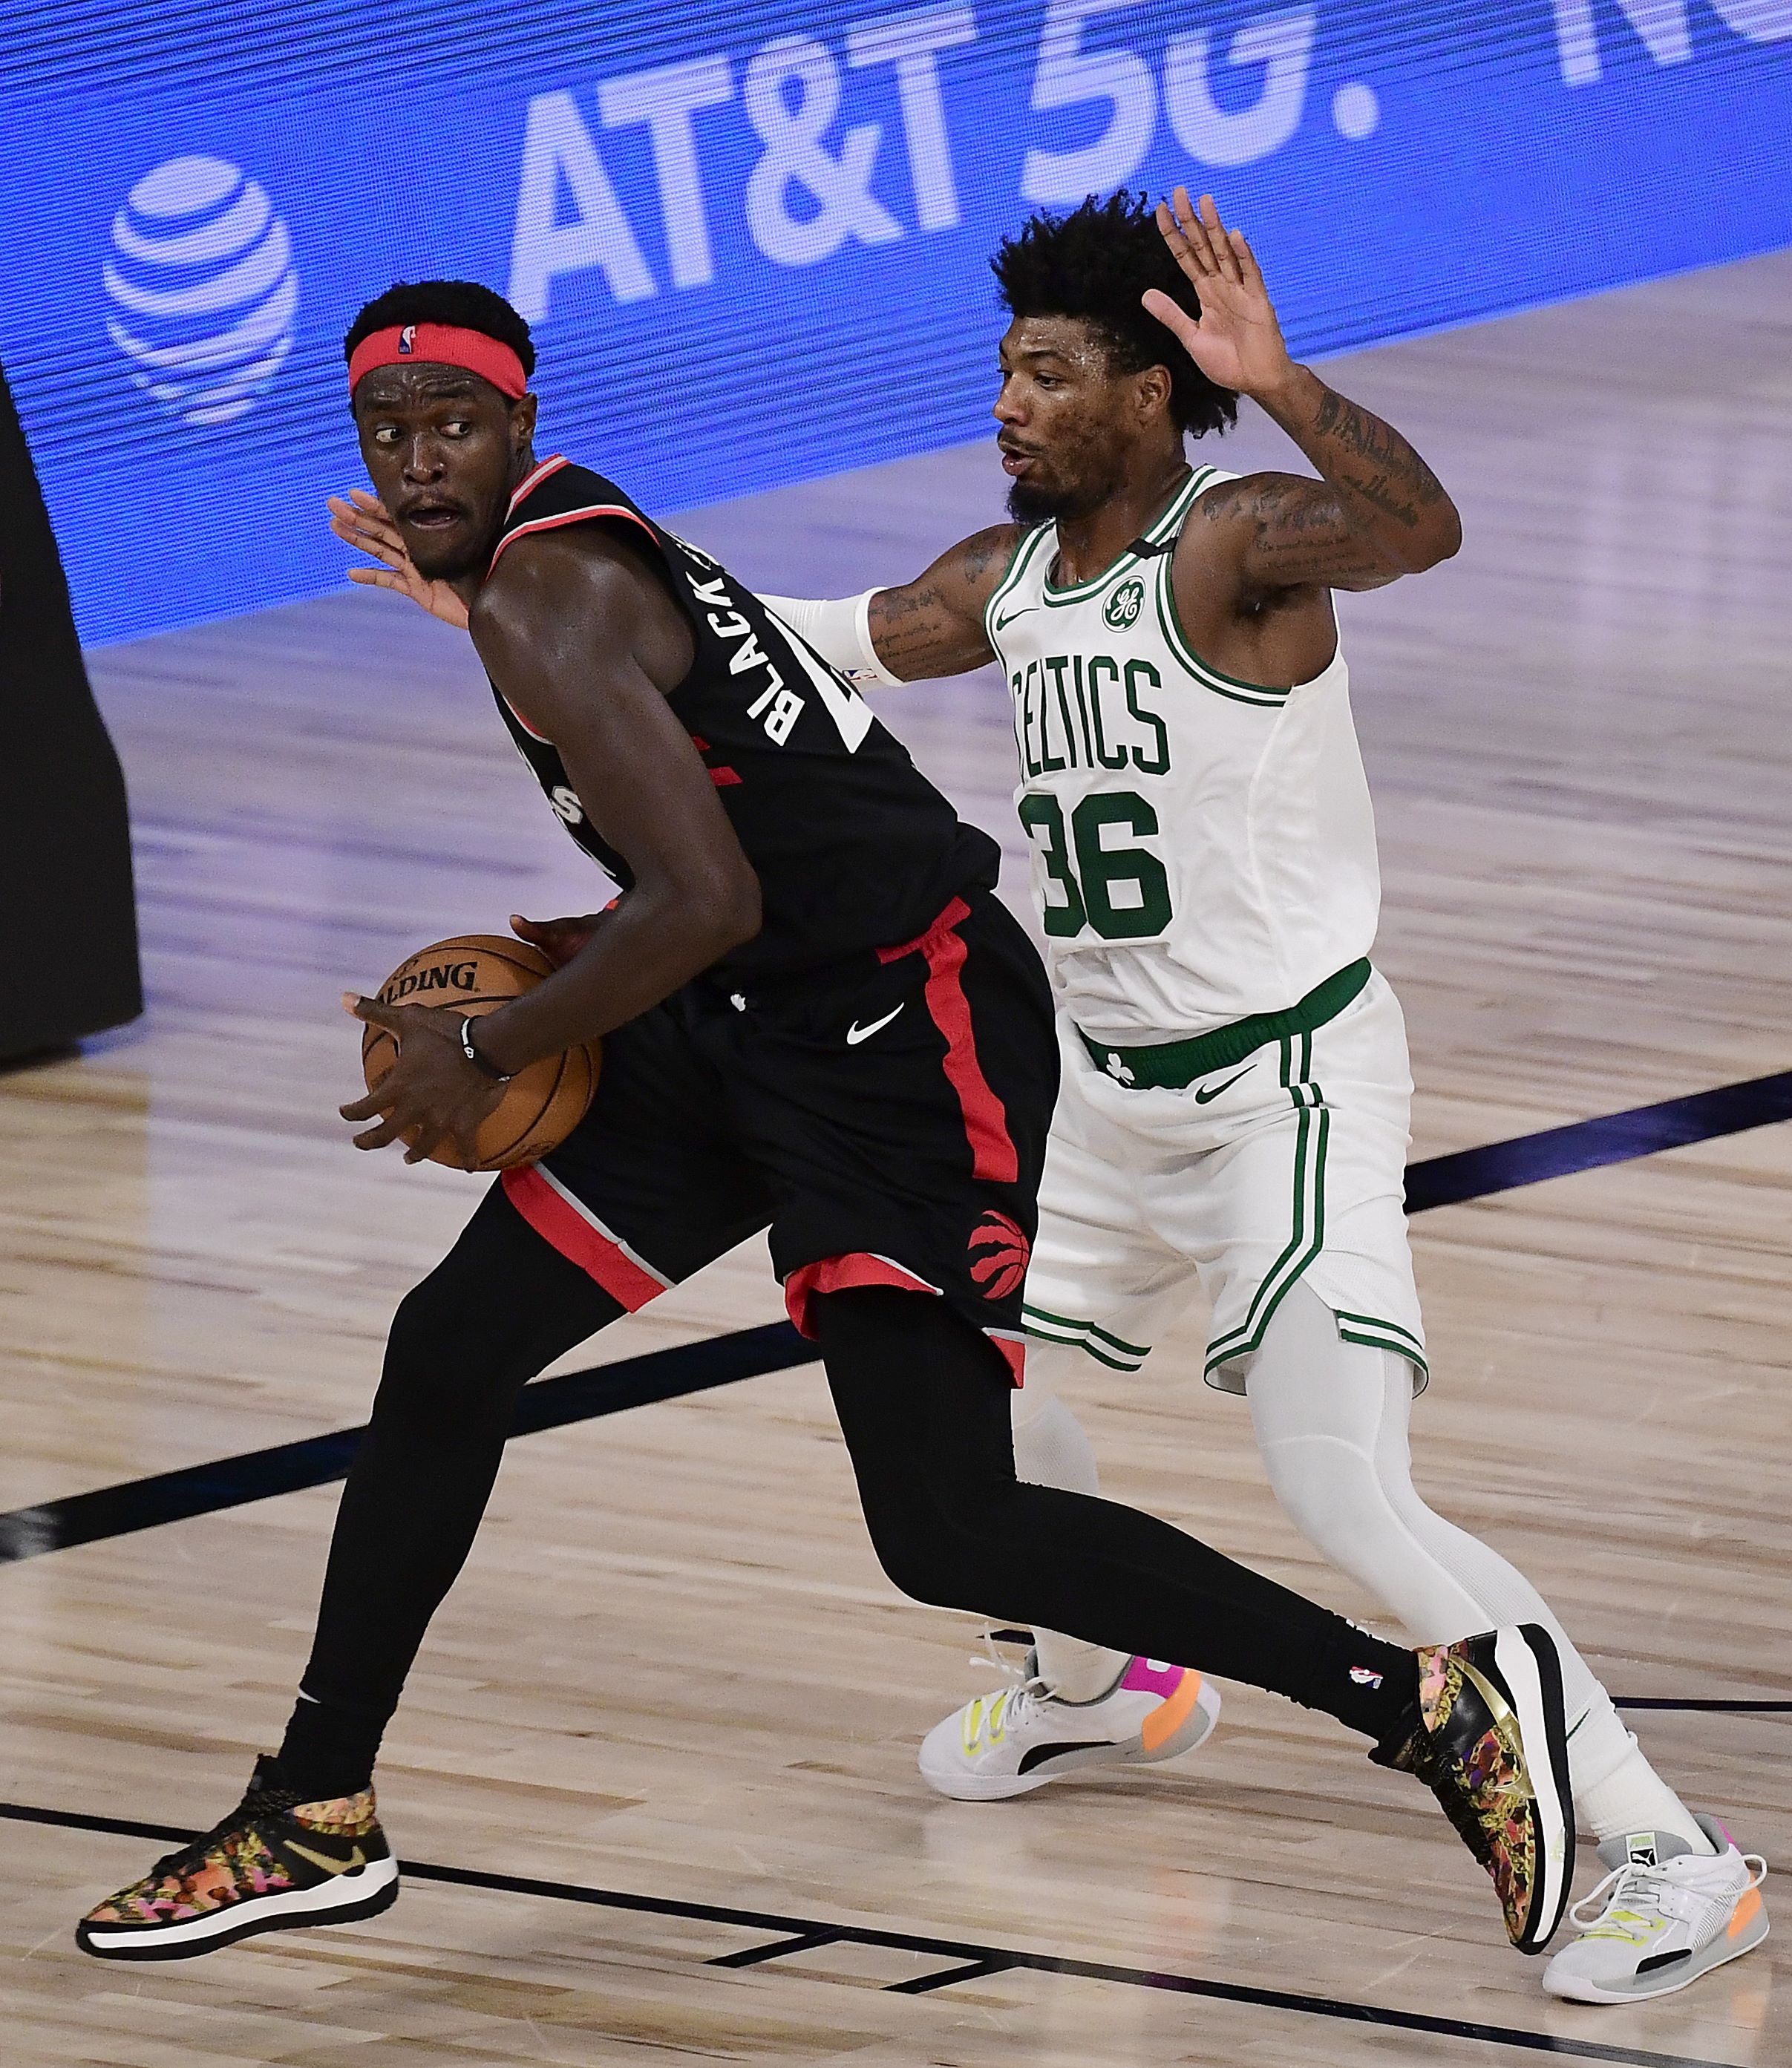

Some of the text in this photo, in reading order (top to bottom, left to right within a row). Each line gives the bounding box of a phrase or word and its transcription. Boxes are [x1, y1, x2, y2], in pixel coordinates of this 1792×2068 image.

[508, 3, 978, 322] AT&T
[684, 571, 805, 746] BLACK
[1018, 792, 1173, 940] 36
